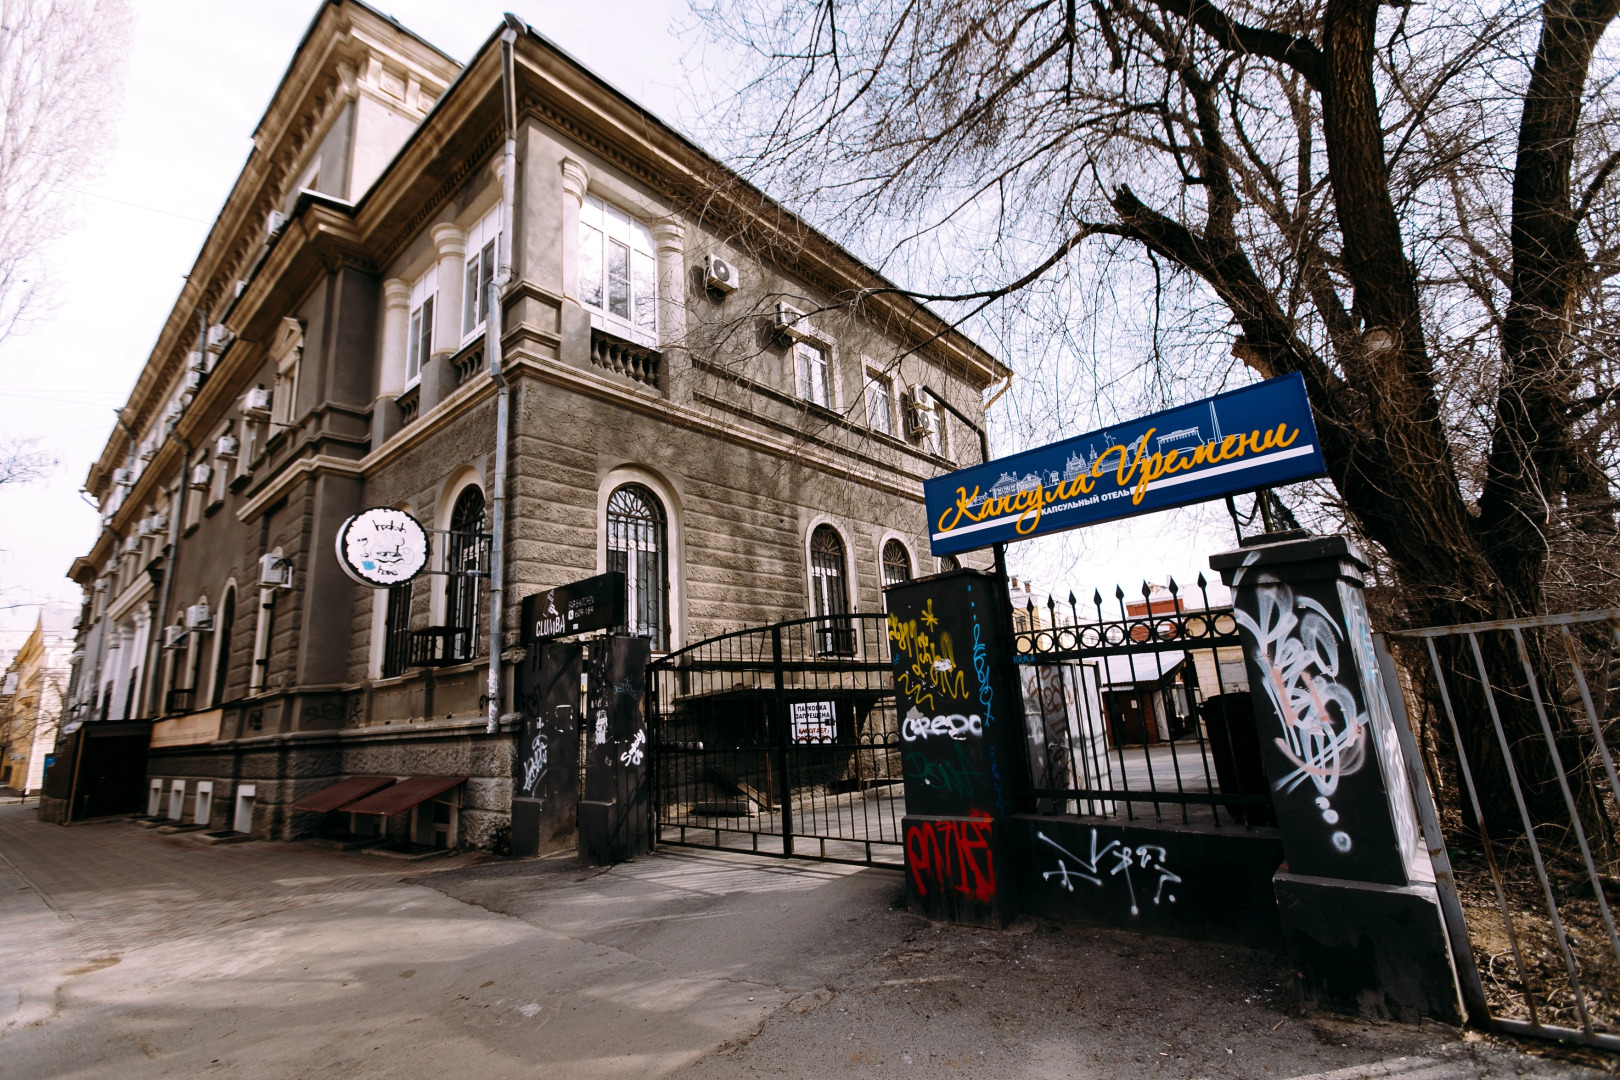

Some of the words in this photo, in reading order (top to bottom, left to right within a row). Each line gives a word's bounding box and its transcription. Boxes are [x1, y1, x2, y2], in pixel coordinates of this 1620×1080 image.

[938, 473, 1096, 535] Капсула
[1041, 494, 1100, 515] КАПСУЛЬНЫЙ
[1101, 489, 1131, 501] ОТЕЛЬ
[536, 614, 566, 637] CLUMBA
